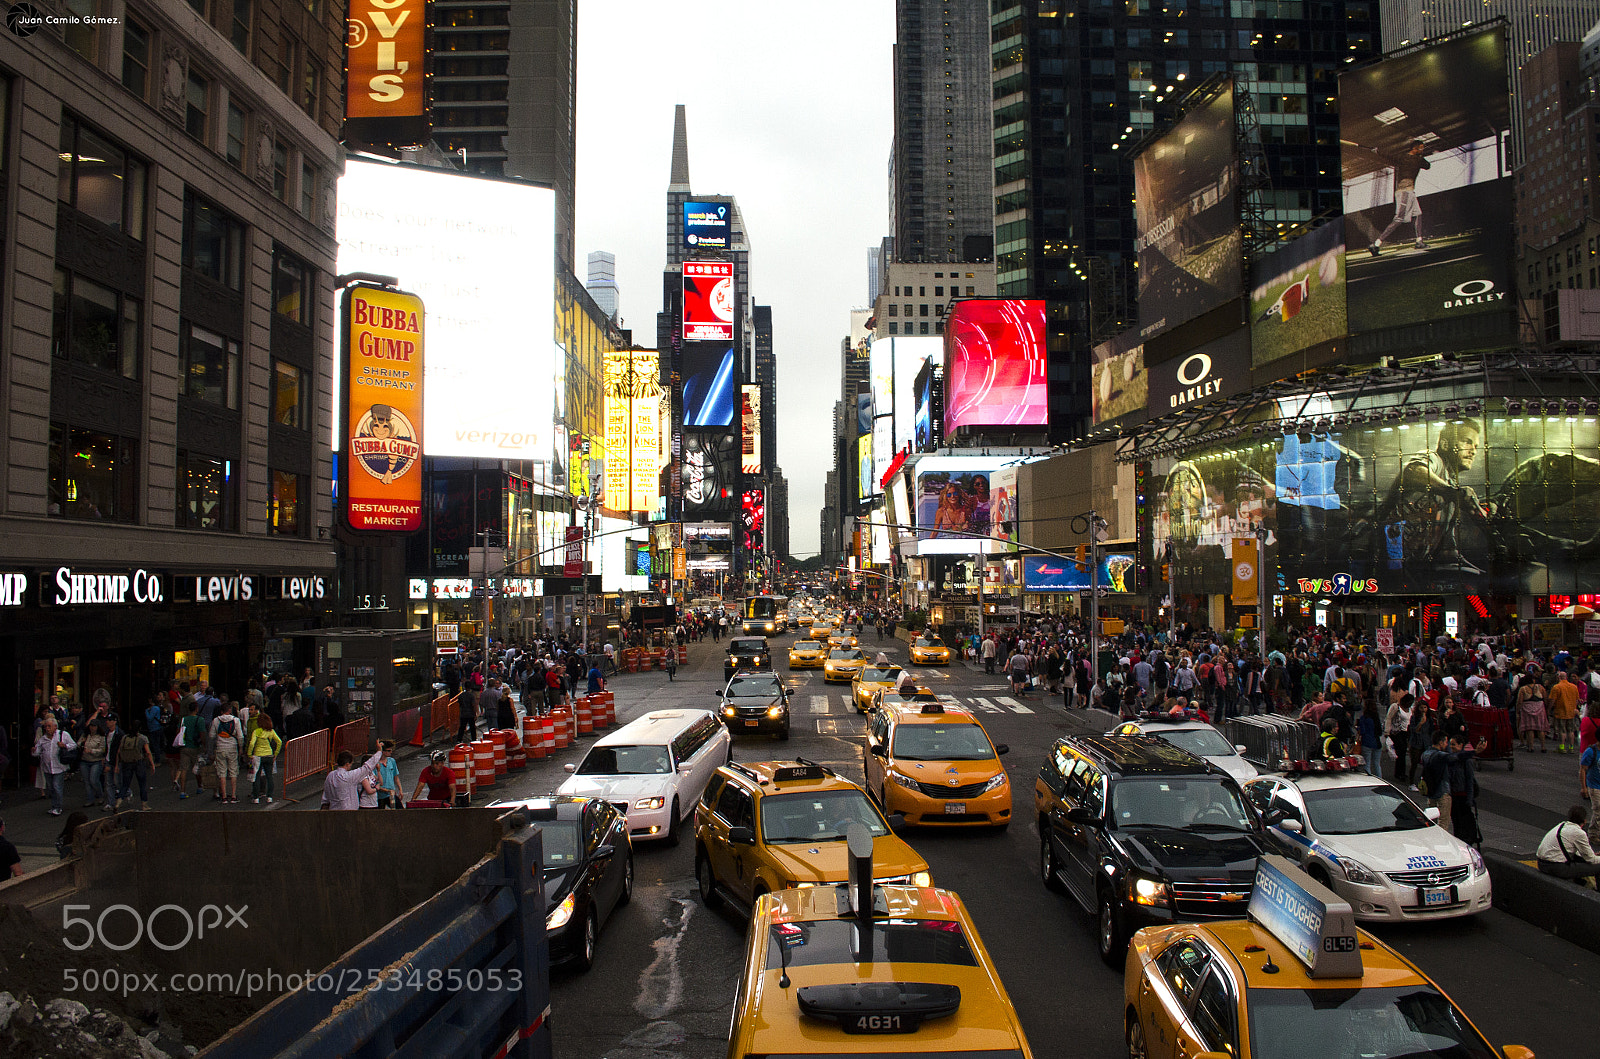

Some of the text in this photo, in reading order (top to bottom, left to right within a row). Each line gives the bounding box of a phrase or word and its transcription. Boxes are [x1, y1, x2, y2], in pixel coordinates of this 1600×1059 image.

[1443, 292, 1506, 309] OAKLEY
[354, 298, 420, 333] BUBBA
[359, 331, 415, 362] GUMP
[363, 366, 410, 378] SHRIMP
[356, 376, 416, 390] COMPANY
[1170, 377, 1223, 408] OAKLEY
[454, 427, 539, 449] verizon
[634, 434, 657, 449] KING
[353, 440, 418, 457] BUBBA GUMP
[352, 503, 420, 514] RESTAURANT
[364, 516, 408, 526] MARKET
[56, 566, 164, 605] SHRIMP CO.
[1353, 578, 1378, 593] US
[438, 625, 457, 633] BELLA
[1405, 860, 1447, 870] POLICE
[1407, 855, 1436, 863] NYPD
[1255, 870, 1278, 896] CREST
[1277, 885, 1284, 905] IS
[1425, 892, 1447, 902] 5371
[857, 1016, 901, 1030] 4G31
